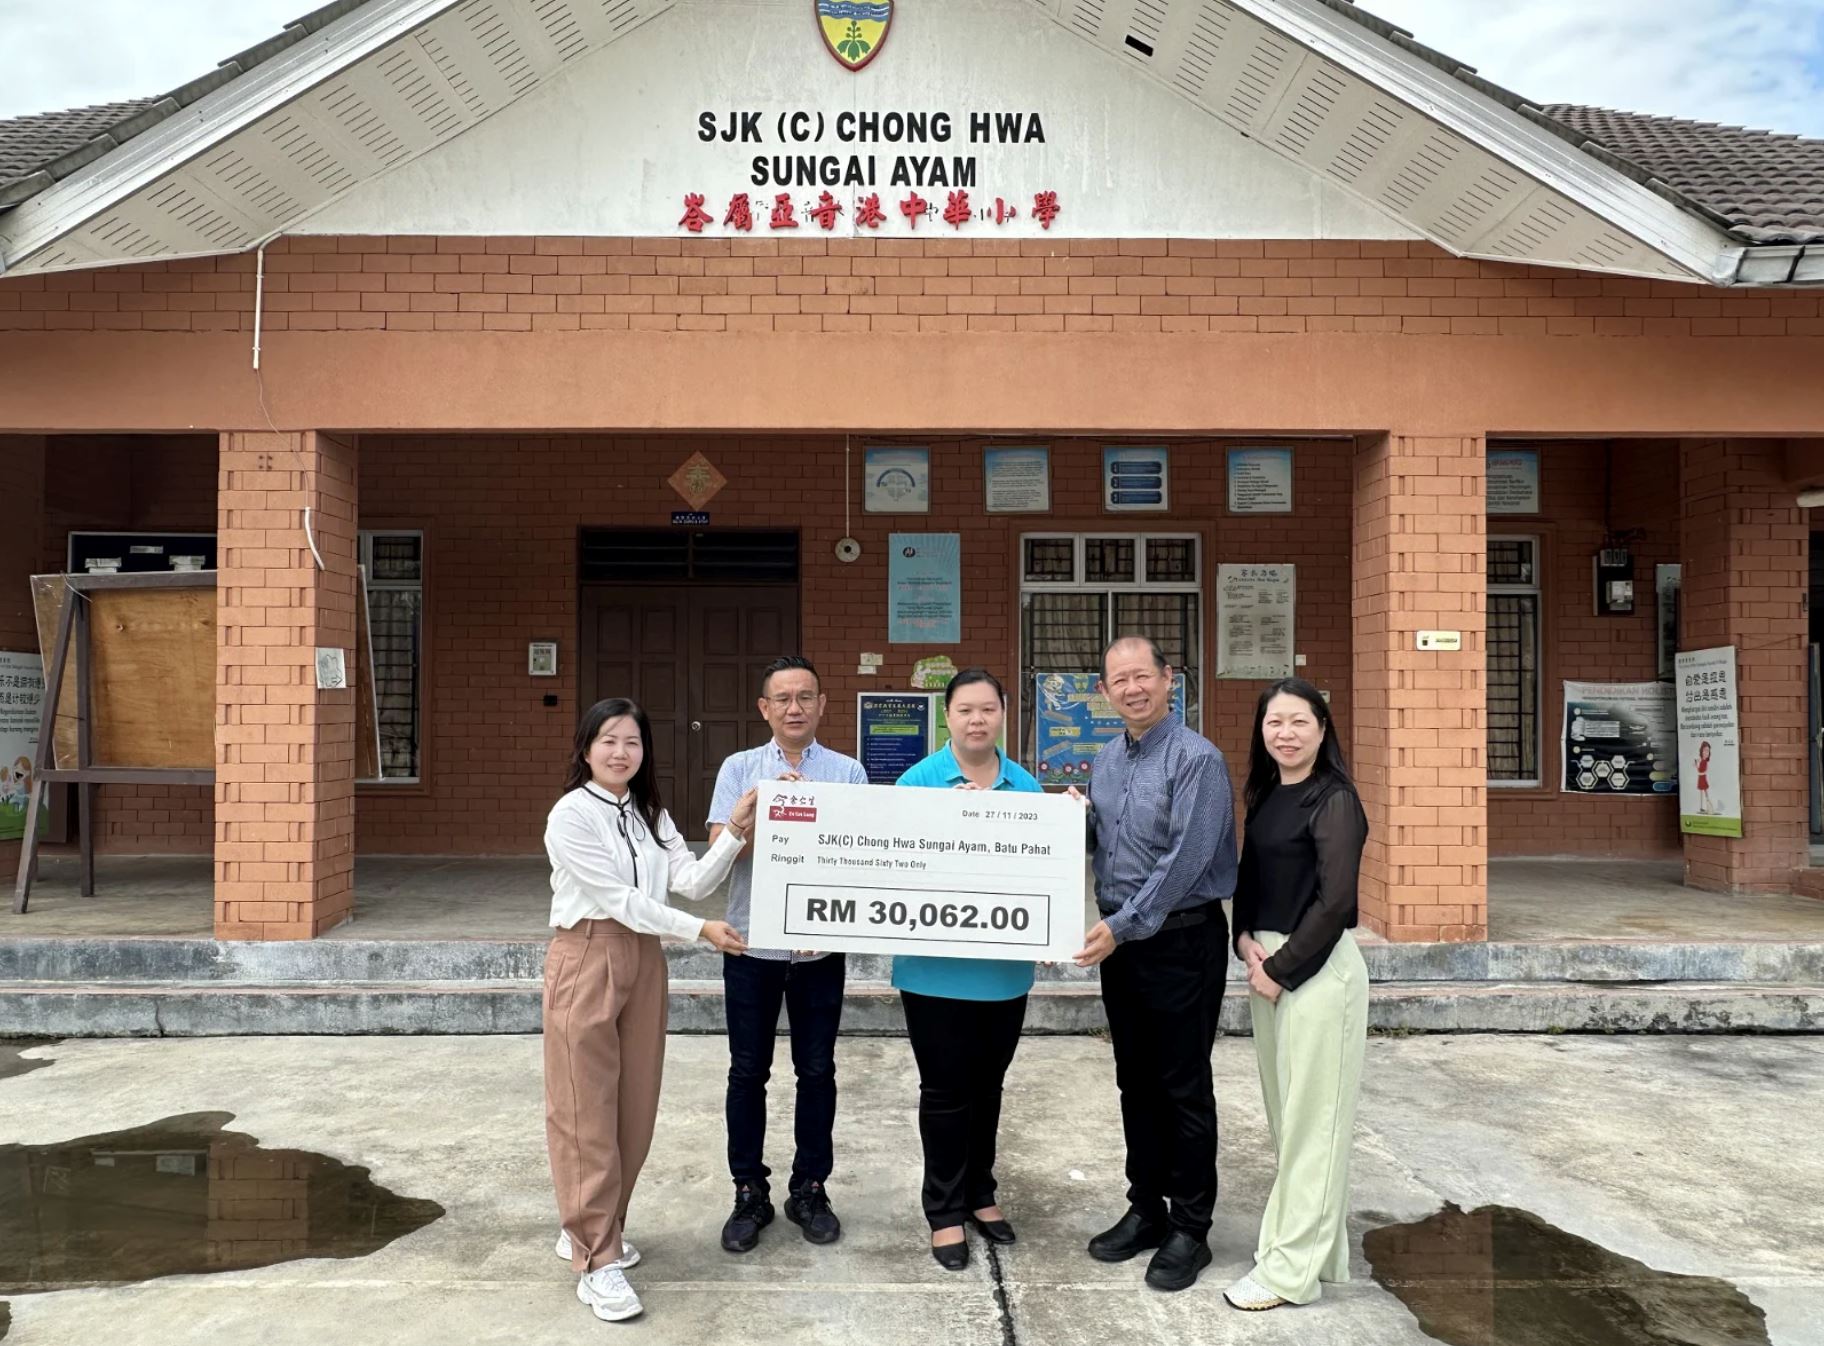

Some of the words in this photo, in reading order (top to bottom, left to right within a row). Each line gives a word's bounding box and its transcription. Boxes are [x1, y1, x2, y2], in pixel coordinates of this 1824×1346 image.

[696, 111, 763, 143] SJK
[777, 111, 825, 143] (C)
[836, 111, 952, 143] CHONG
[969, 112, 1046, 144] HWA
[750, 155, 876, 187] SUNGAI
[890, 156, 977, 188] AYAM
[962, 809, 980, 818] Date
[985, 810, 995, 818] 27
[1018, 812, 1038, 821] 2023
[771, 834, 790, 846] Pay
[817, 833, 854, 849] SJK(C)
[857, 834, 889, 850] Chong
[893, 836, 915, 849] Hwa
[918, 838, 955, 853] Sungai
[958, 840, 991, 854] Ayam,
[994, 841, 1018, 854] Batu
[1021, 842, 1051, 856] Pahat
[770, 853, 805, 865] Ringgit
[817, 855, 838, 866] Thirty
[839, 856, 873, 866] Thousand
[875, 858, 893, 869] Sixty
[895, 859, 909, 868] Two
[910, 860, 927, 871] Only
[806, 897, 856, 924] RM
[868, 899, 1030, 932] 30,062.00
